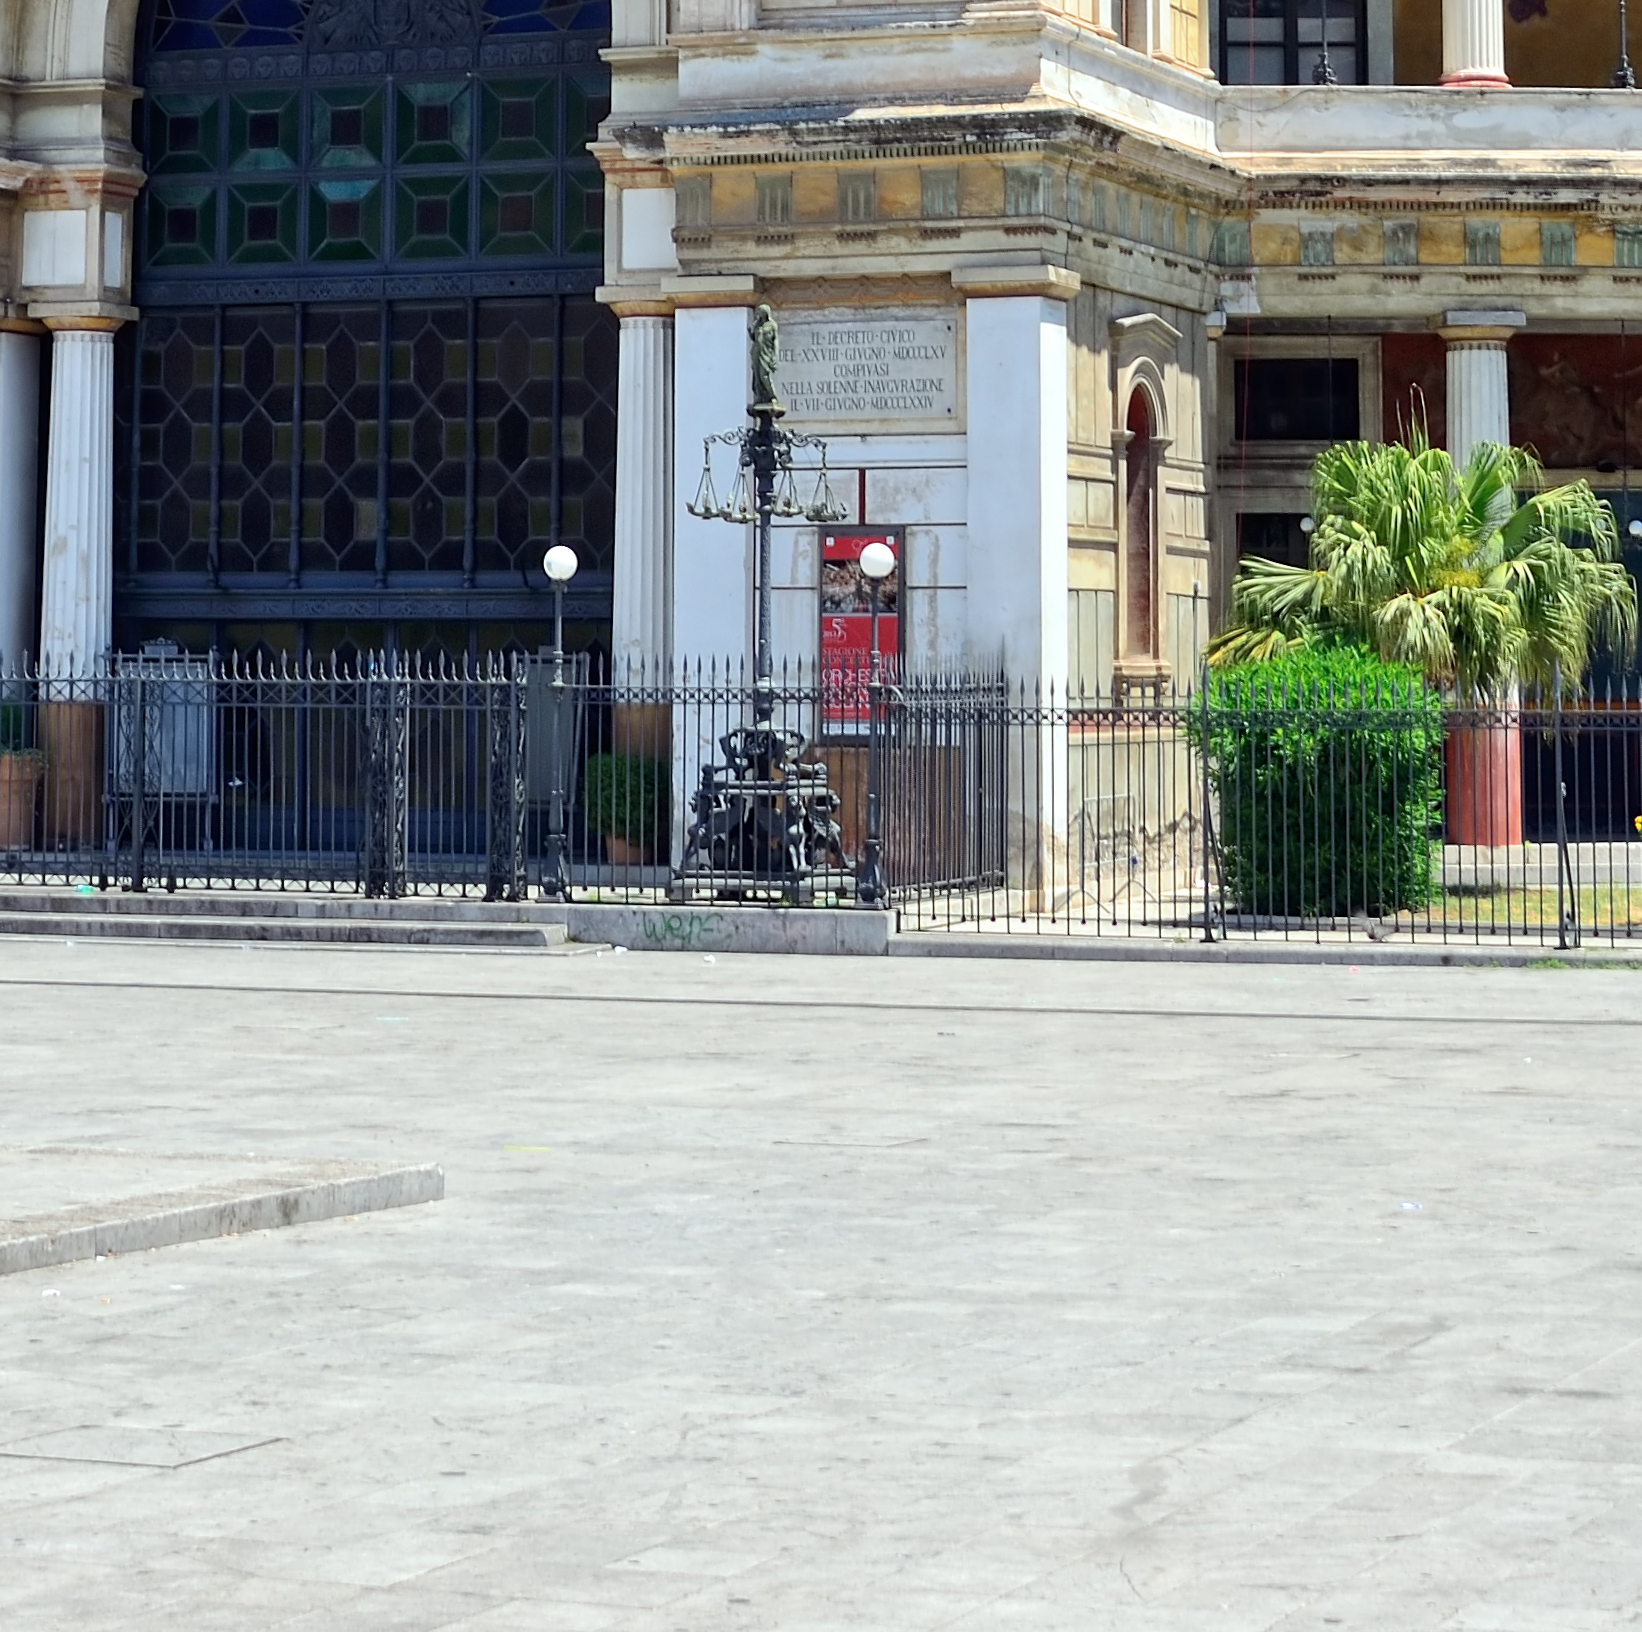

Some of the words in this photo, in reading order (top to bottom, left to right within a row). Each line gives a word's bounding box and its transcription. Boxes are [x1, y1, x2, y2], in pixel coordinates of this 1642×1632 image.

[828, 330, 874, 345] DECRETO
[880, 329, 915, 343] CIVICO
[779, 349, 796, 362] DEL
[781, 381, 813, 395] NELLA
[817, 380, 859, 394] SOLENNE
[790, 399, 800, 411] IL
